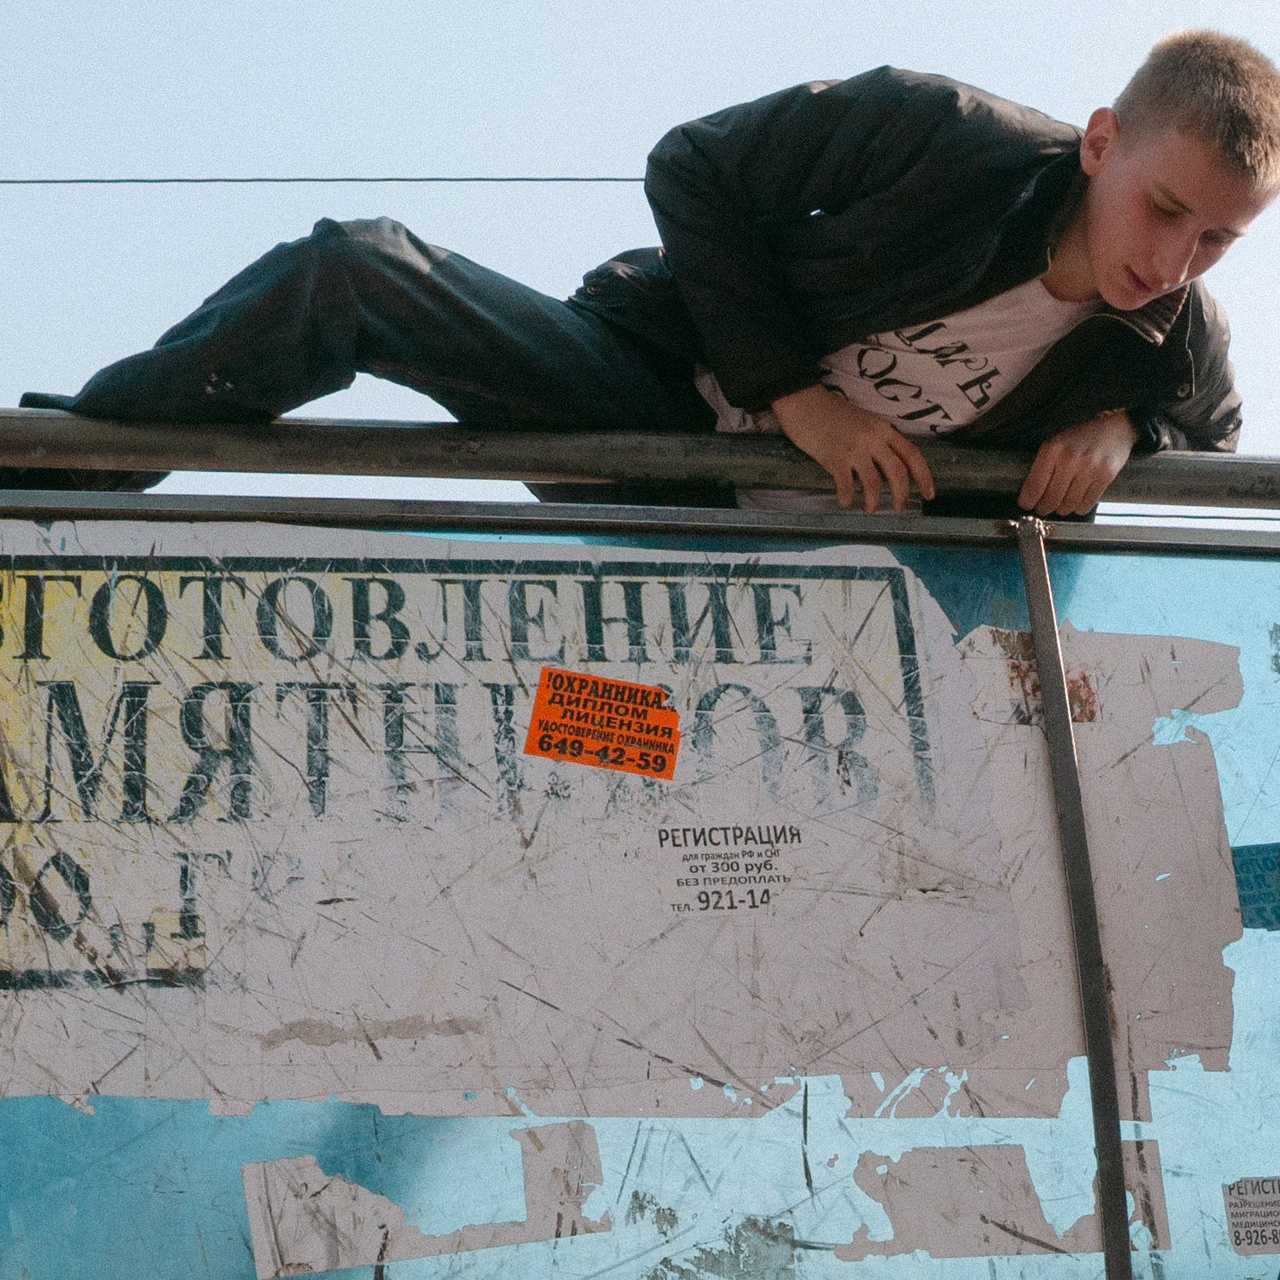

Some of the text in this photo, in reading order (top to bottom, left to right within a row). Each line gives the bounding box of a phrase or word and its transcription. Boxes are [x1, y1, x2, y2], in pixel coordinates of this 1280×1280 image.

[0, 573, 813, 666] ГОТОВЛЕНИЕ
[547, 692, 649, 721] ДИПЛОМ
[560, 708, 673, 739] ЛИЦЕНЗИЯ
[538, 734, 667, 773] 649-42-59
[658, 825, 802, 848] РЕГИСТРАЦИЯ
[682, 853, 698, 863] для
[701, 852, 739, 861] граждан
[742, 850, 754, 859] РФ
[765, 849, 781, 858] СНГ
[689, 860, 778, 875] от 300 руб.
[676, 878, 699, 887] БЕЗ
[1229, 1200, 1280, 1209] РАЗРЕШЕНИЕ
